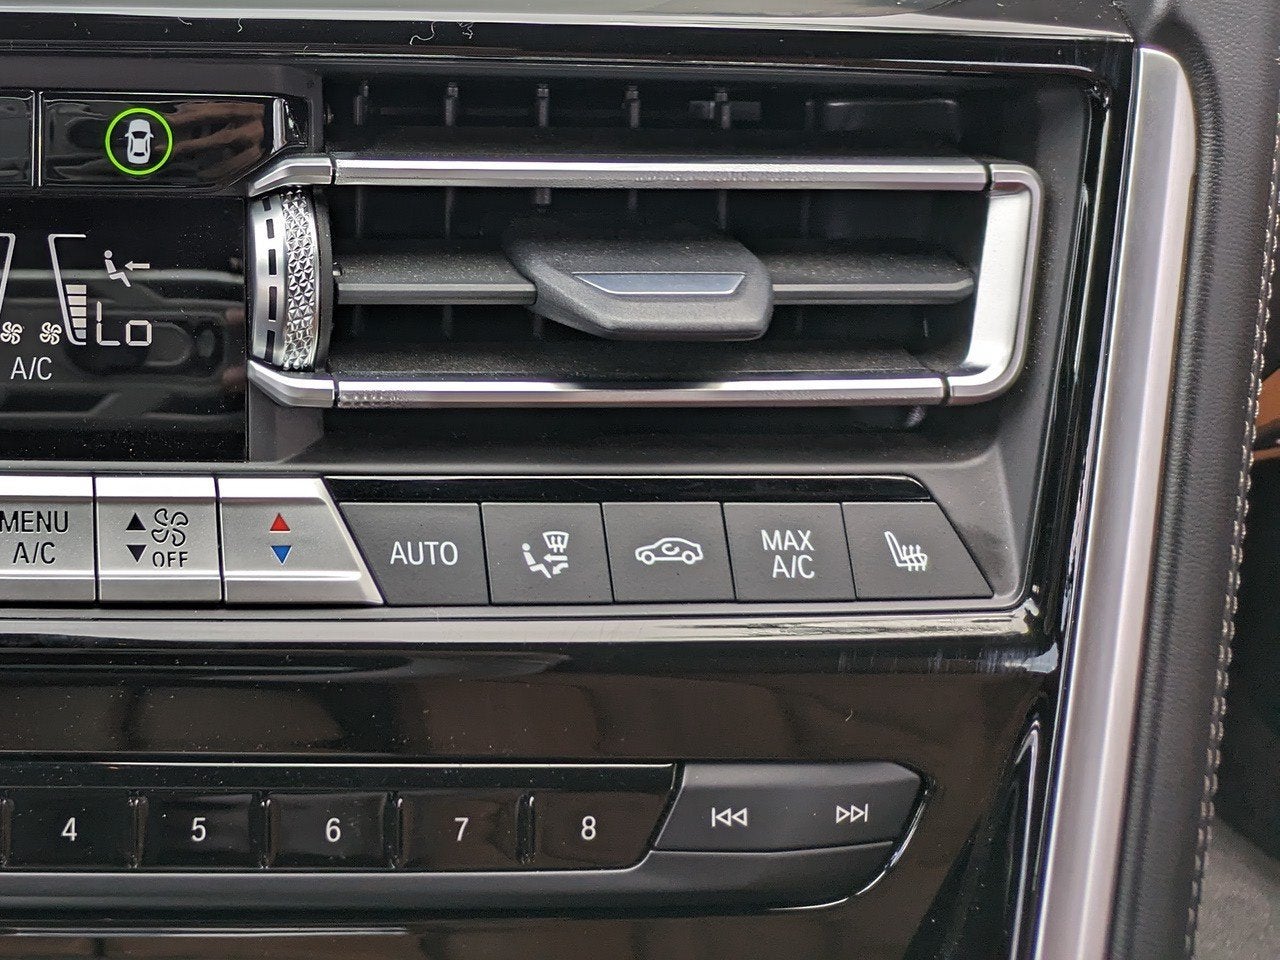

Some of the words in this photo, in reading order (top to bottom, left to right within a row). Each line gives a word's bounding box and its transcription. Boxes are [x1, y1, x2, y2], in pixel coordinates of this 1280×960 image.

[96, 301, 152, 347] Lo
[10, 356, 52, 381] A/C
[761, 529, 815, 552] MAX
[13, 542, 55, 565] A/C
[152, 550, 188, 568] OFF
[390, 541, 459, 566] AUTO
[771, 556, 815, 580] A/C
[61, 817, 78, 842] 4
[190, 817, 207, 842] 5
[325, 818, 341, 842] 6
[454, 818, 469, 841] 7
[581, 817, 596, 841] 8
